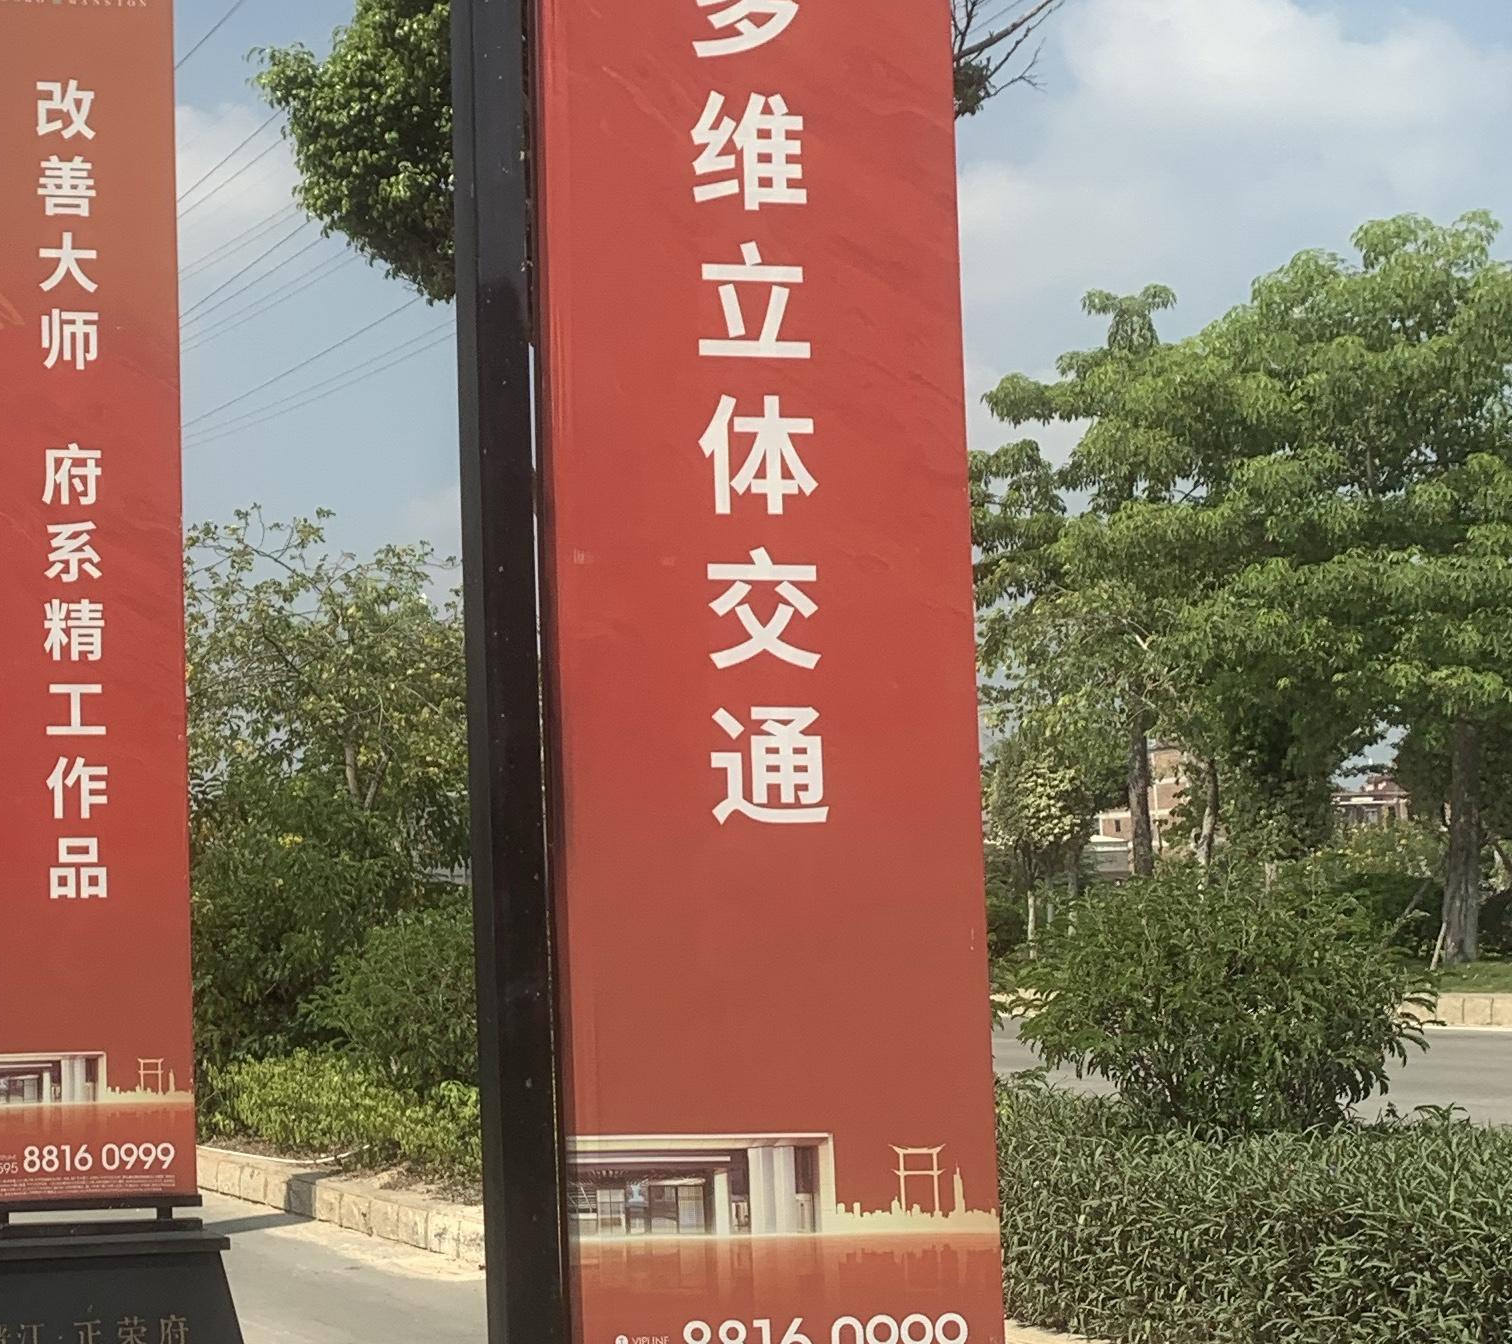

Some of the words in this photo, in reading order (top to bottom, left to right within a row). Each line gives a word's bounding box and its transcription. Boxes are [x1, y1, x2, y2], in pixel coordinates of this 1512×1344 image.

[35, 79, 98, 371] 改善大师
[41, 442, 108, 899] 府系精工作品
[23, 1145, 93, 1172] 8816
[101, 1143, 175, 1170] 0999
